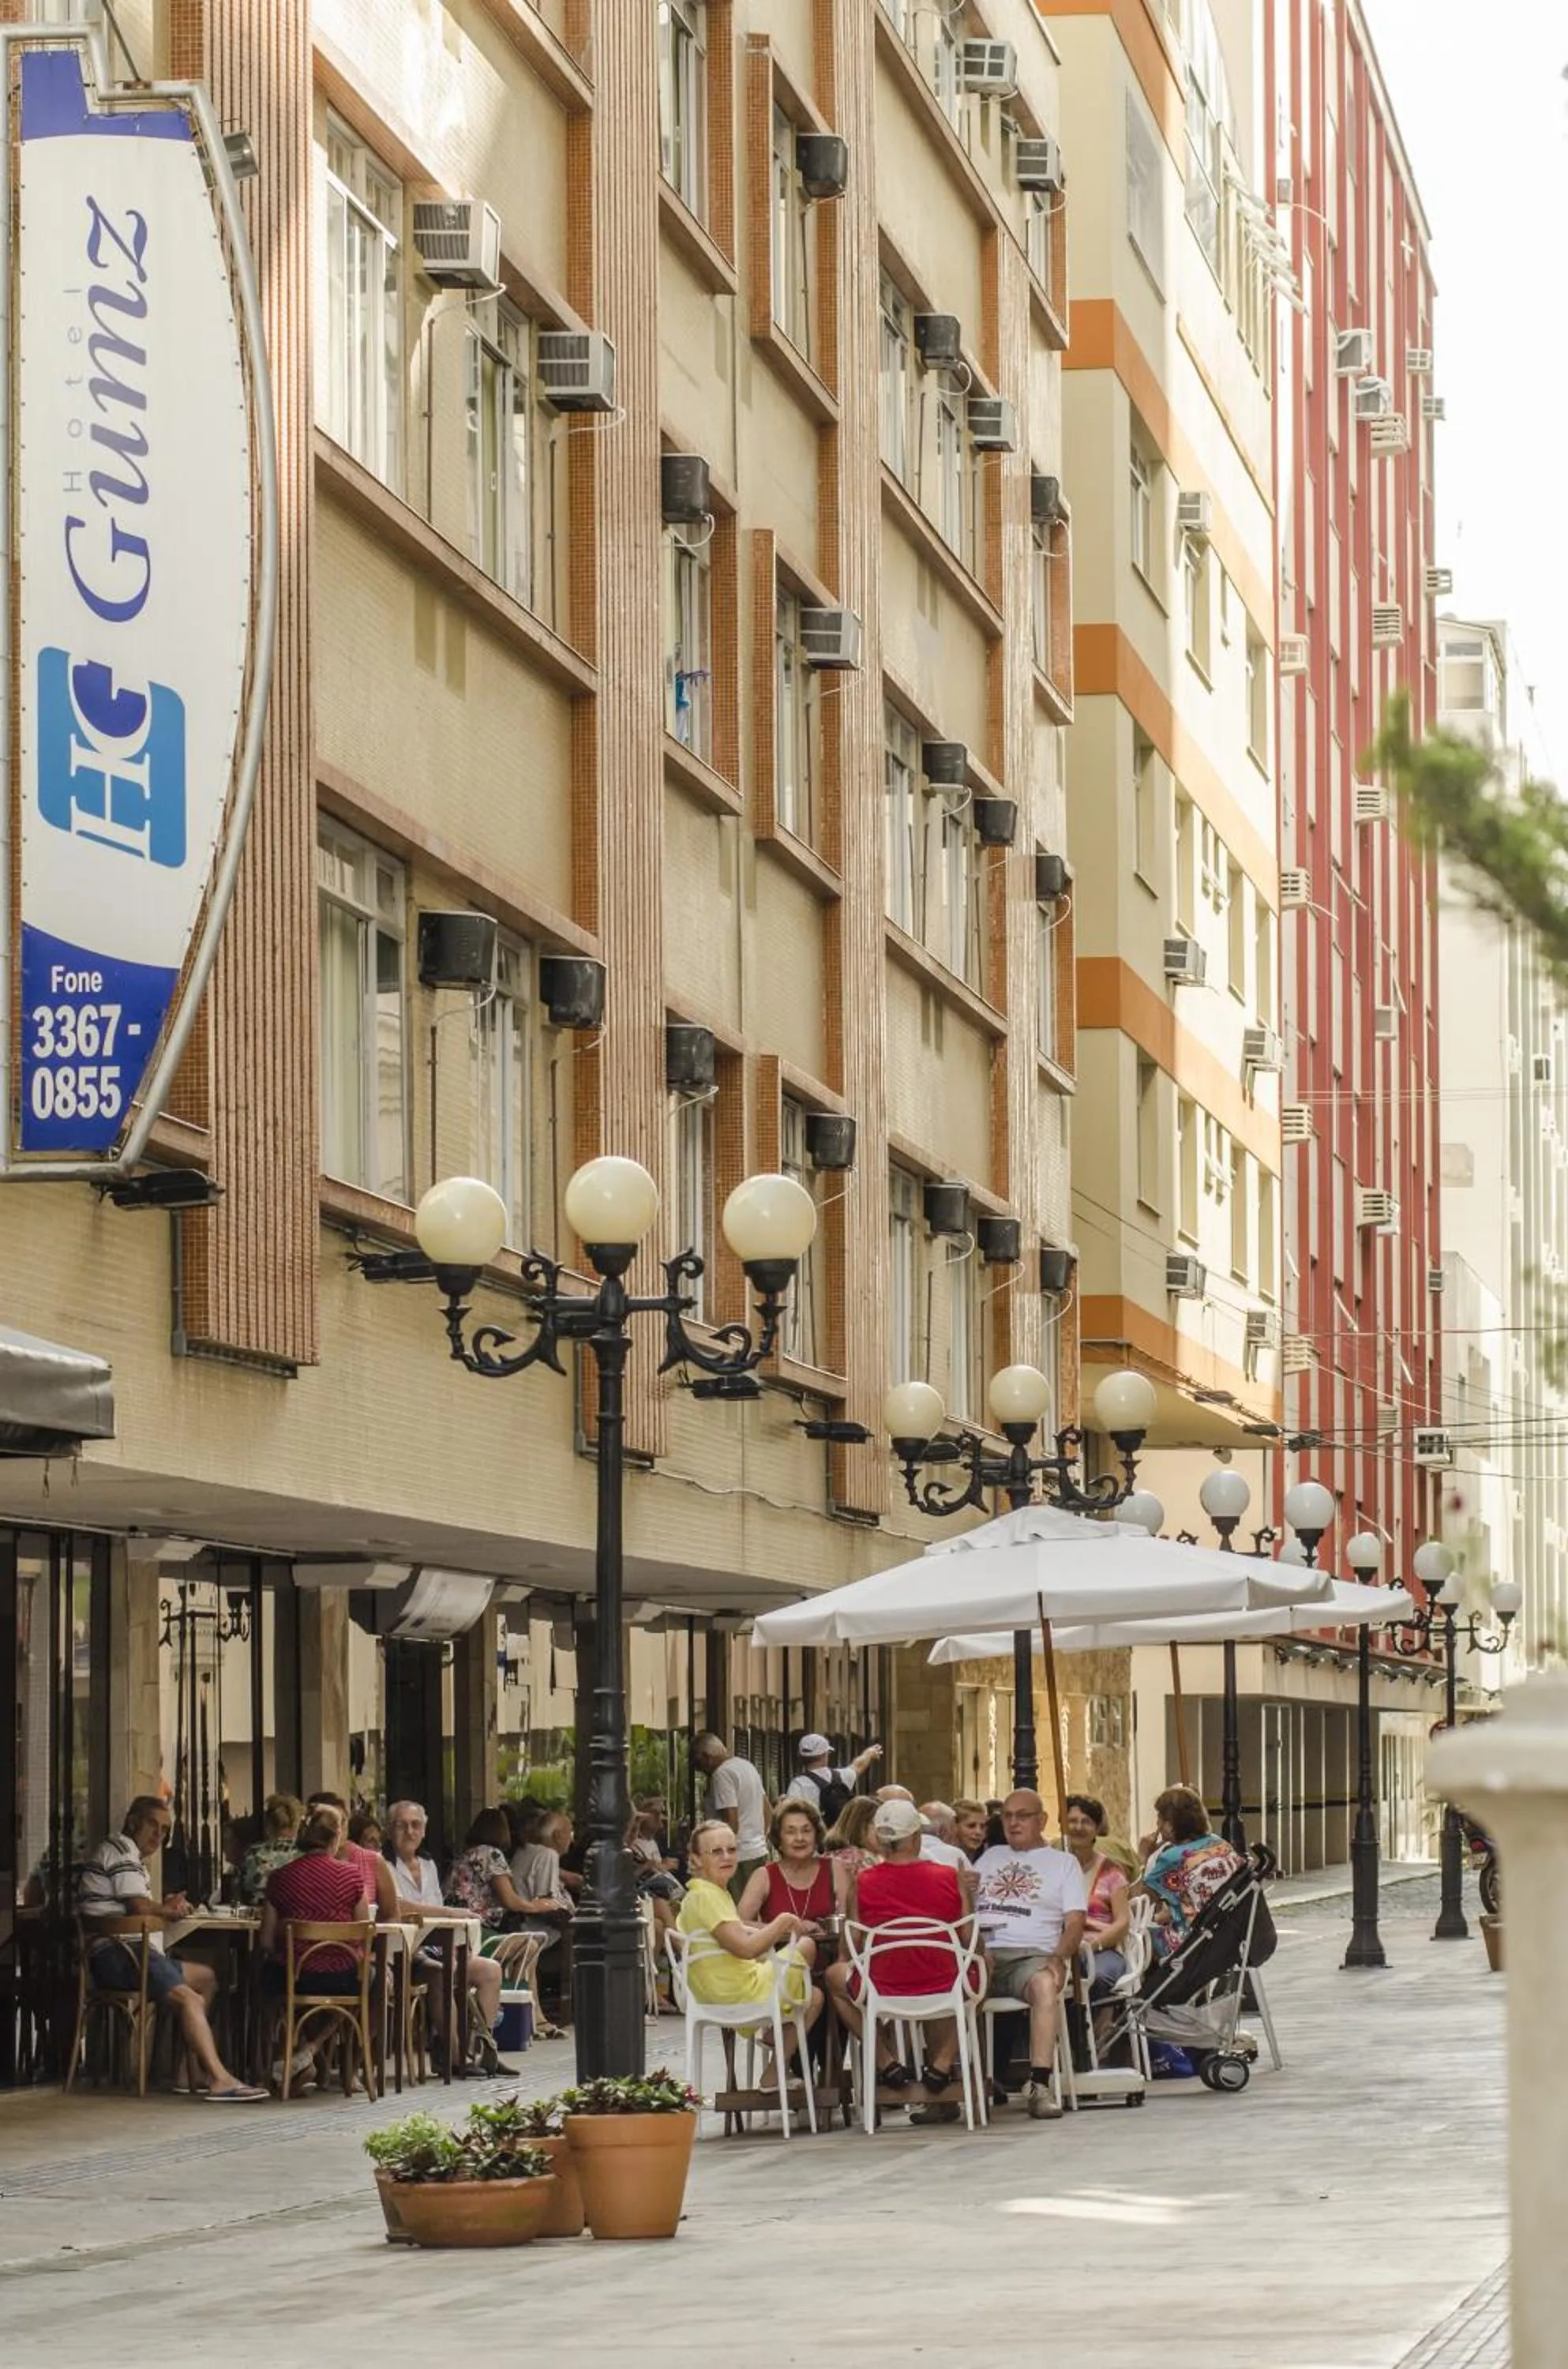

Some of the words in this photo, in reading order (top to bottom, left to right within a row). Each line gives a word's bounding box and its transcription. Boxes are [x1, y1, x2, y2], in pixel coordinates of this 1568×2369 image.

[64, 288, 82, 493] Hotel
[66, 196, 151, 622] Gumz
[51, 967, 103, 993] Fone
[32, 1066, 121, 1119] 0855
